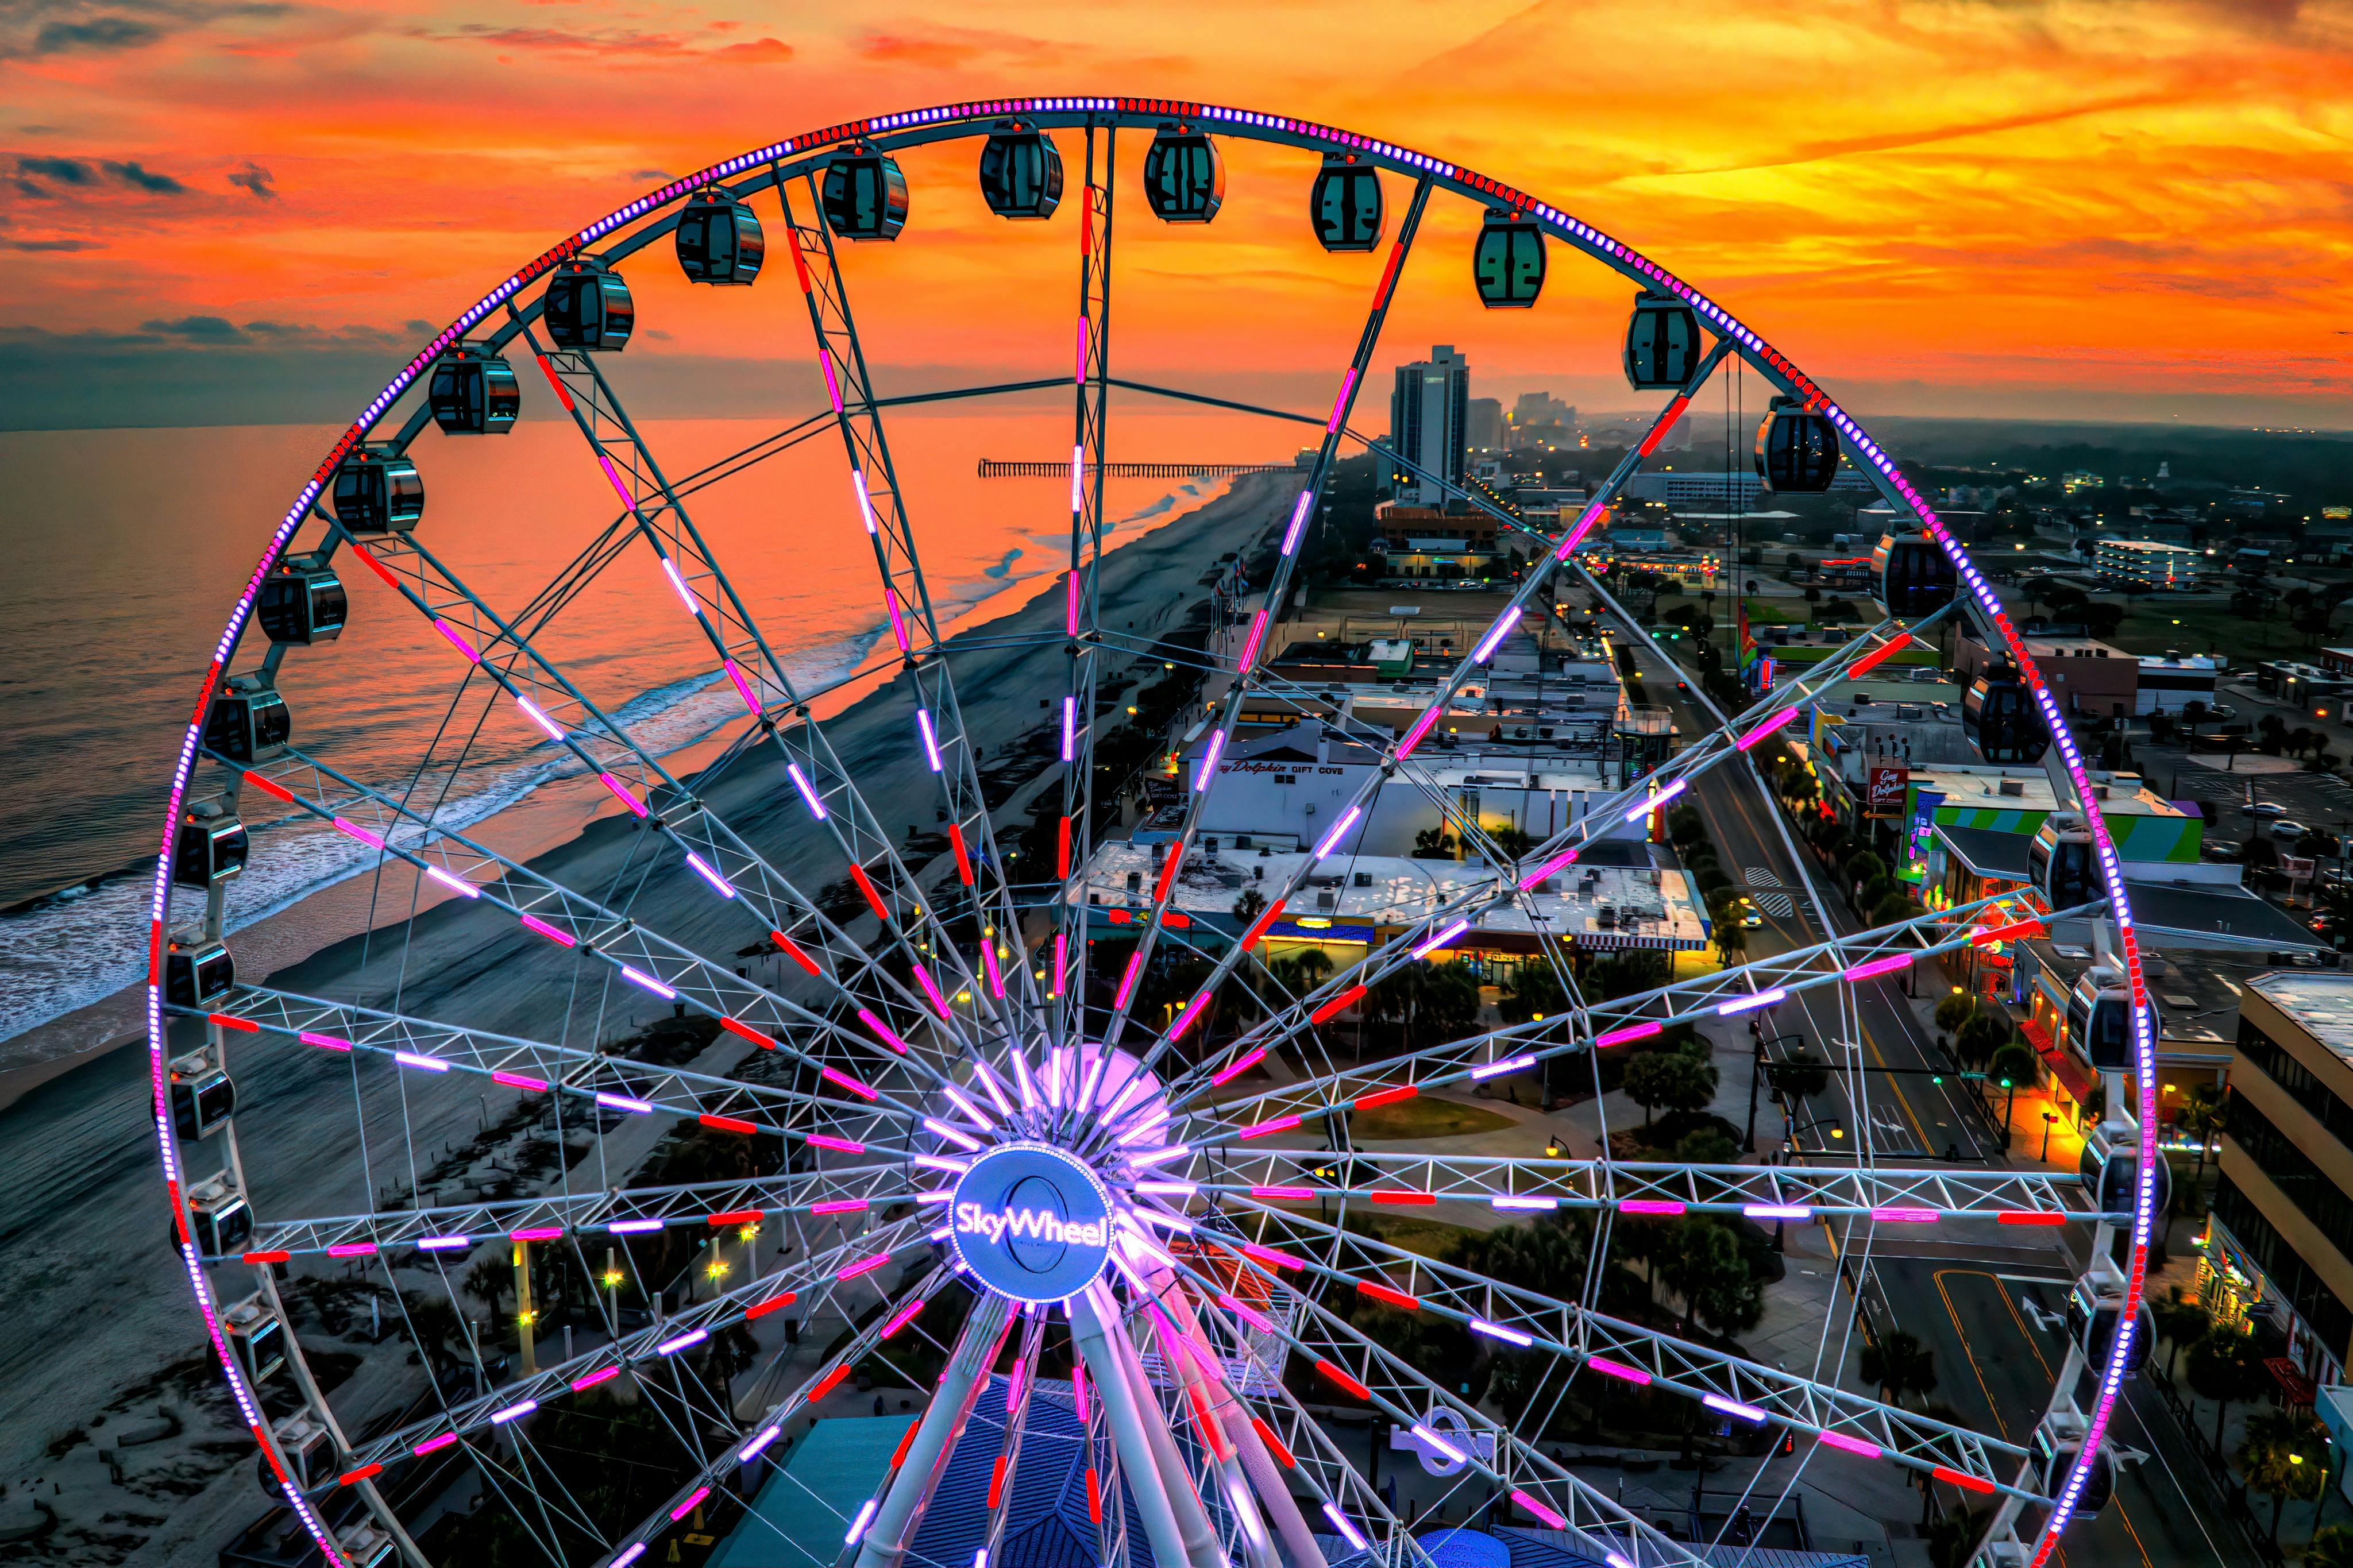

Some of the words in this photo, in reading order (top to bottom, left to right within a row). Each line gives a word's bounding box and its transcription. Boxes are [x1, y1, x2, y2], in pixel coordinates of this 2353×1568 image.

[1232, 760, 1287, 775] Dolphin
[1318, 767, 1343, 775] COVE
[956, 1203, 1107, 1247] SkyWheel
